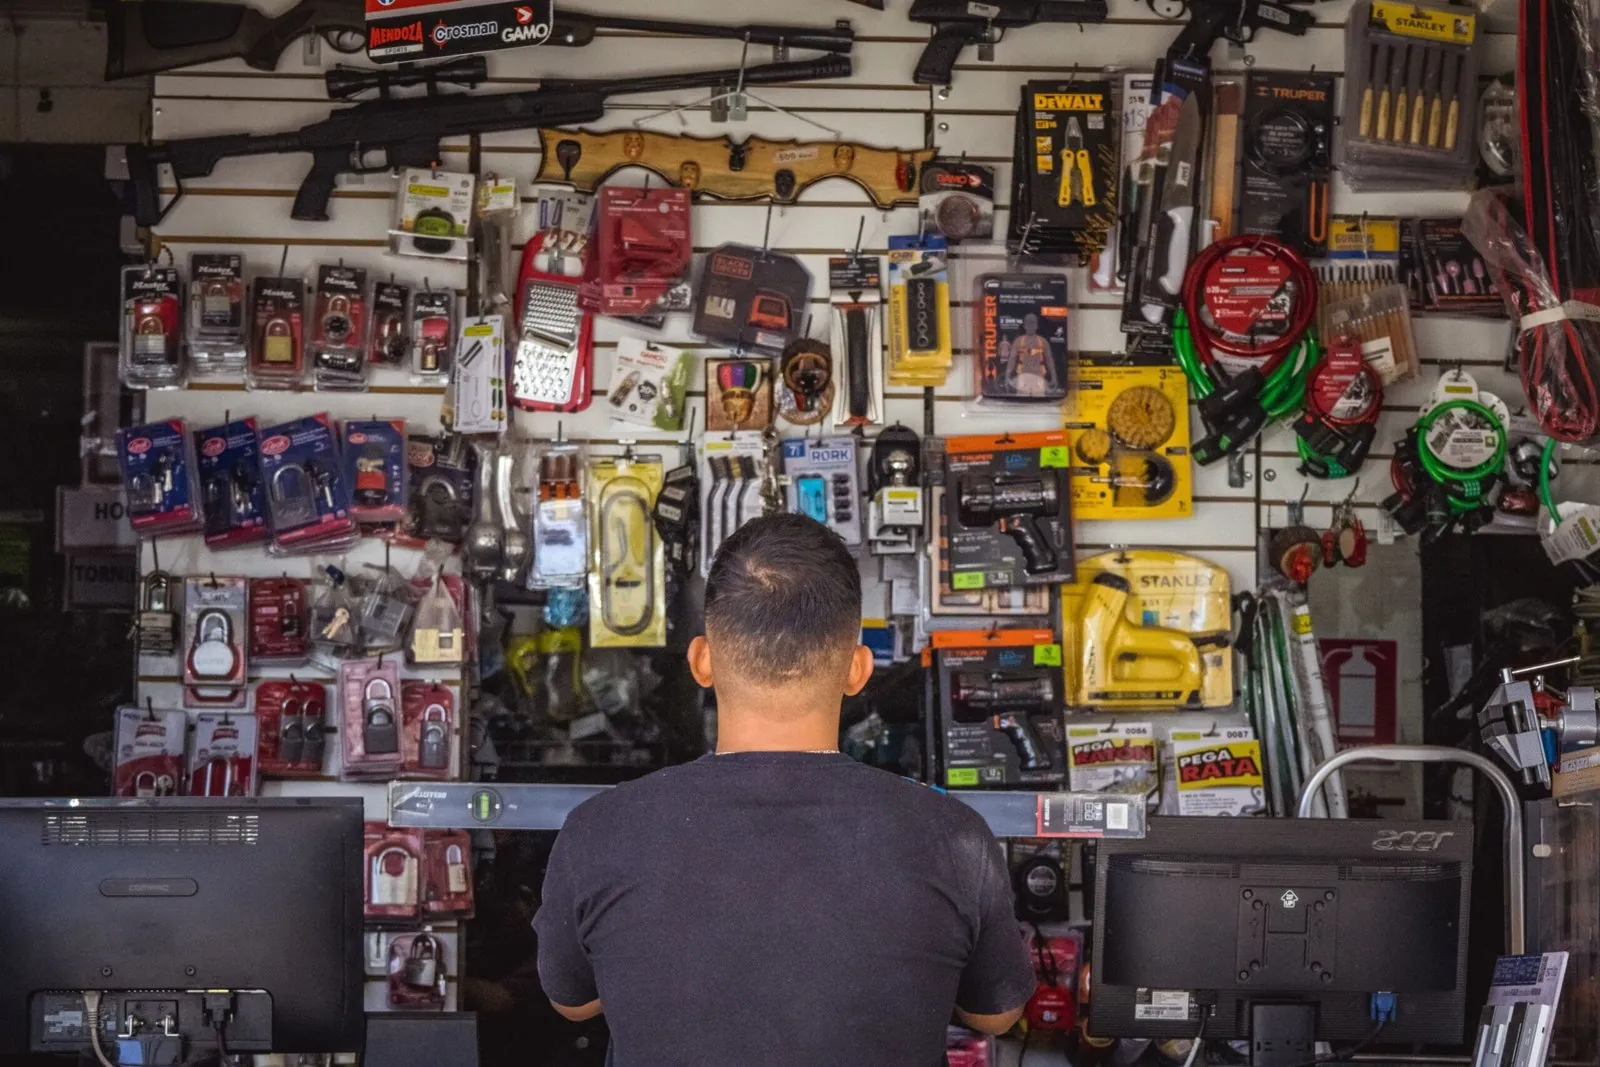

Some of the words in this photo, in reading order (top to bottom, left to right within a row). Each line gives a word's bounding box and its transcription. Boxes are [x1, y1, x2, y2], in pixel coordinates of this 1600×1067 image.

[432, 20, 498, 43] Crosman
[501, 23, 548, 42] GAMO
[1395, 17, 1446, 32] STANLEY
[369, 21, 423, 48] MENDOZA
[1271, 87, 1327, 101] TRUPER
[936, 172, 967, 185] GAMO
[985, 295, 997, 361] TRUPER
[1160, 369, 1167, 379] 3
[811, 450, 849, 461] RORK
[1141, 575, 1214, 588] STANLEY
[1074, 740, 1113, 755] PEGA
[1180, 749, 1231, 767] PEGA
[1182, 759, 1256, 781] RATA
[1371, 829, 1454, 851] acer
